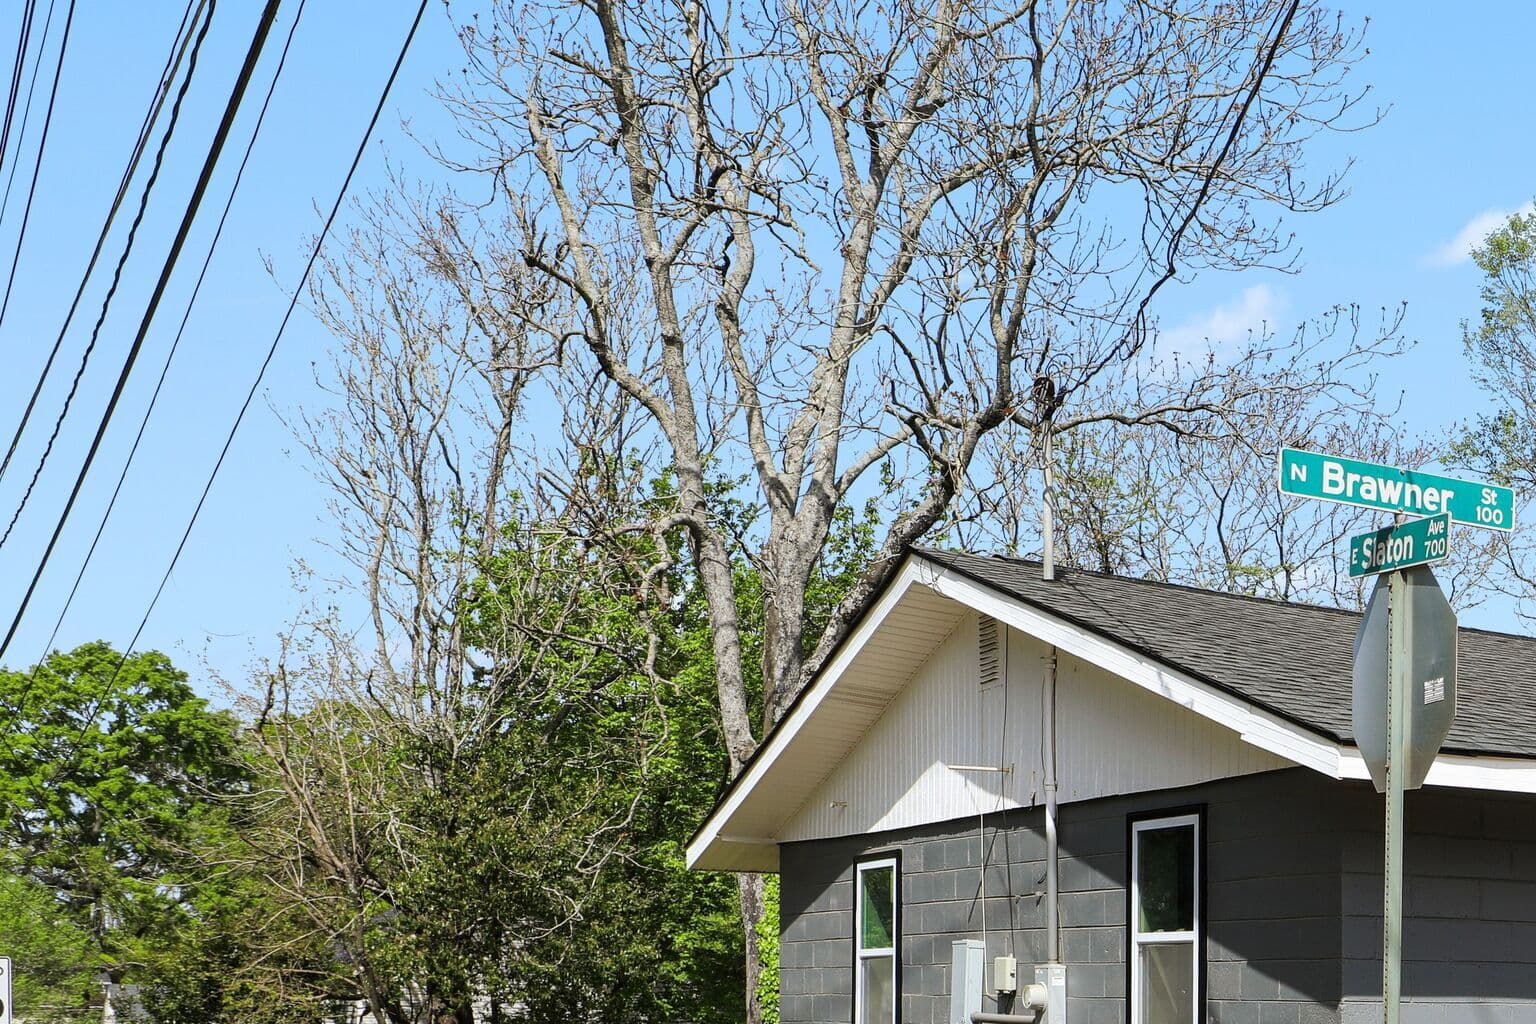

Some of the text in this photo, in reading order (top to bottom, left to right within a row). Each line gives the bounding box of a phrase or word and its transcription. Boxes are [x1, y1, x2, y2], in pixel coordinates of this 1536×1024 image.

[1290, 461, 1498, 514] N Brawner St
[1476, 507, 1503, 525] 100
[1352, 519, 1445, 570] E Slaton Ave
[1424, 537, 1446, 558] 700
